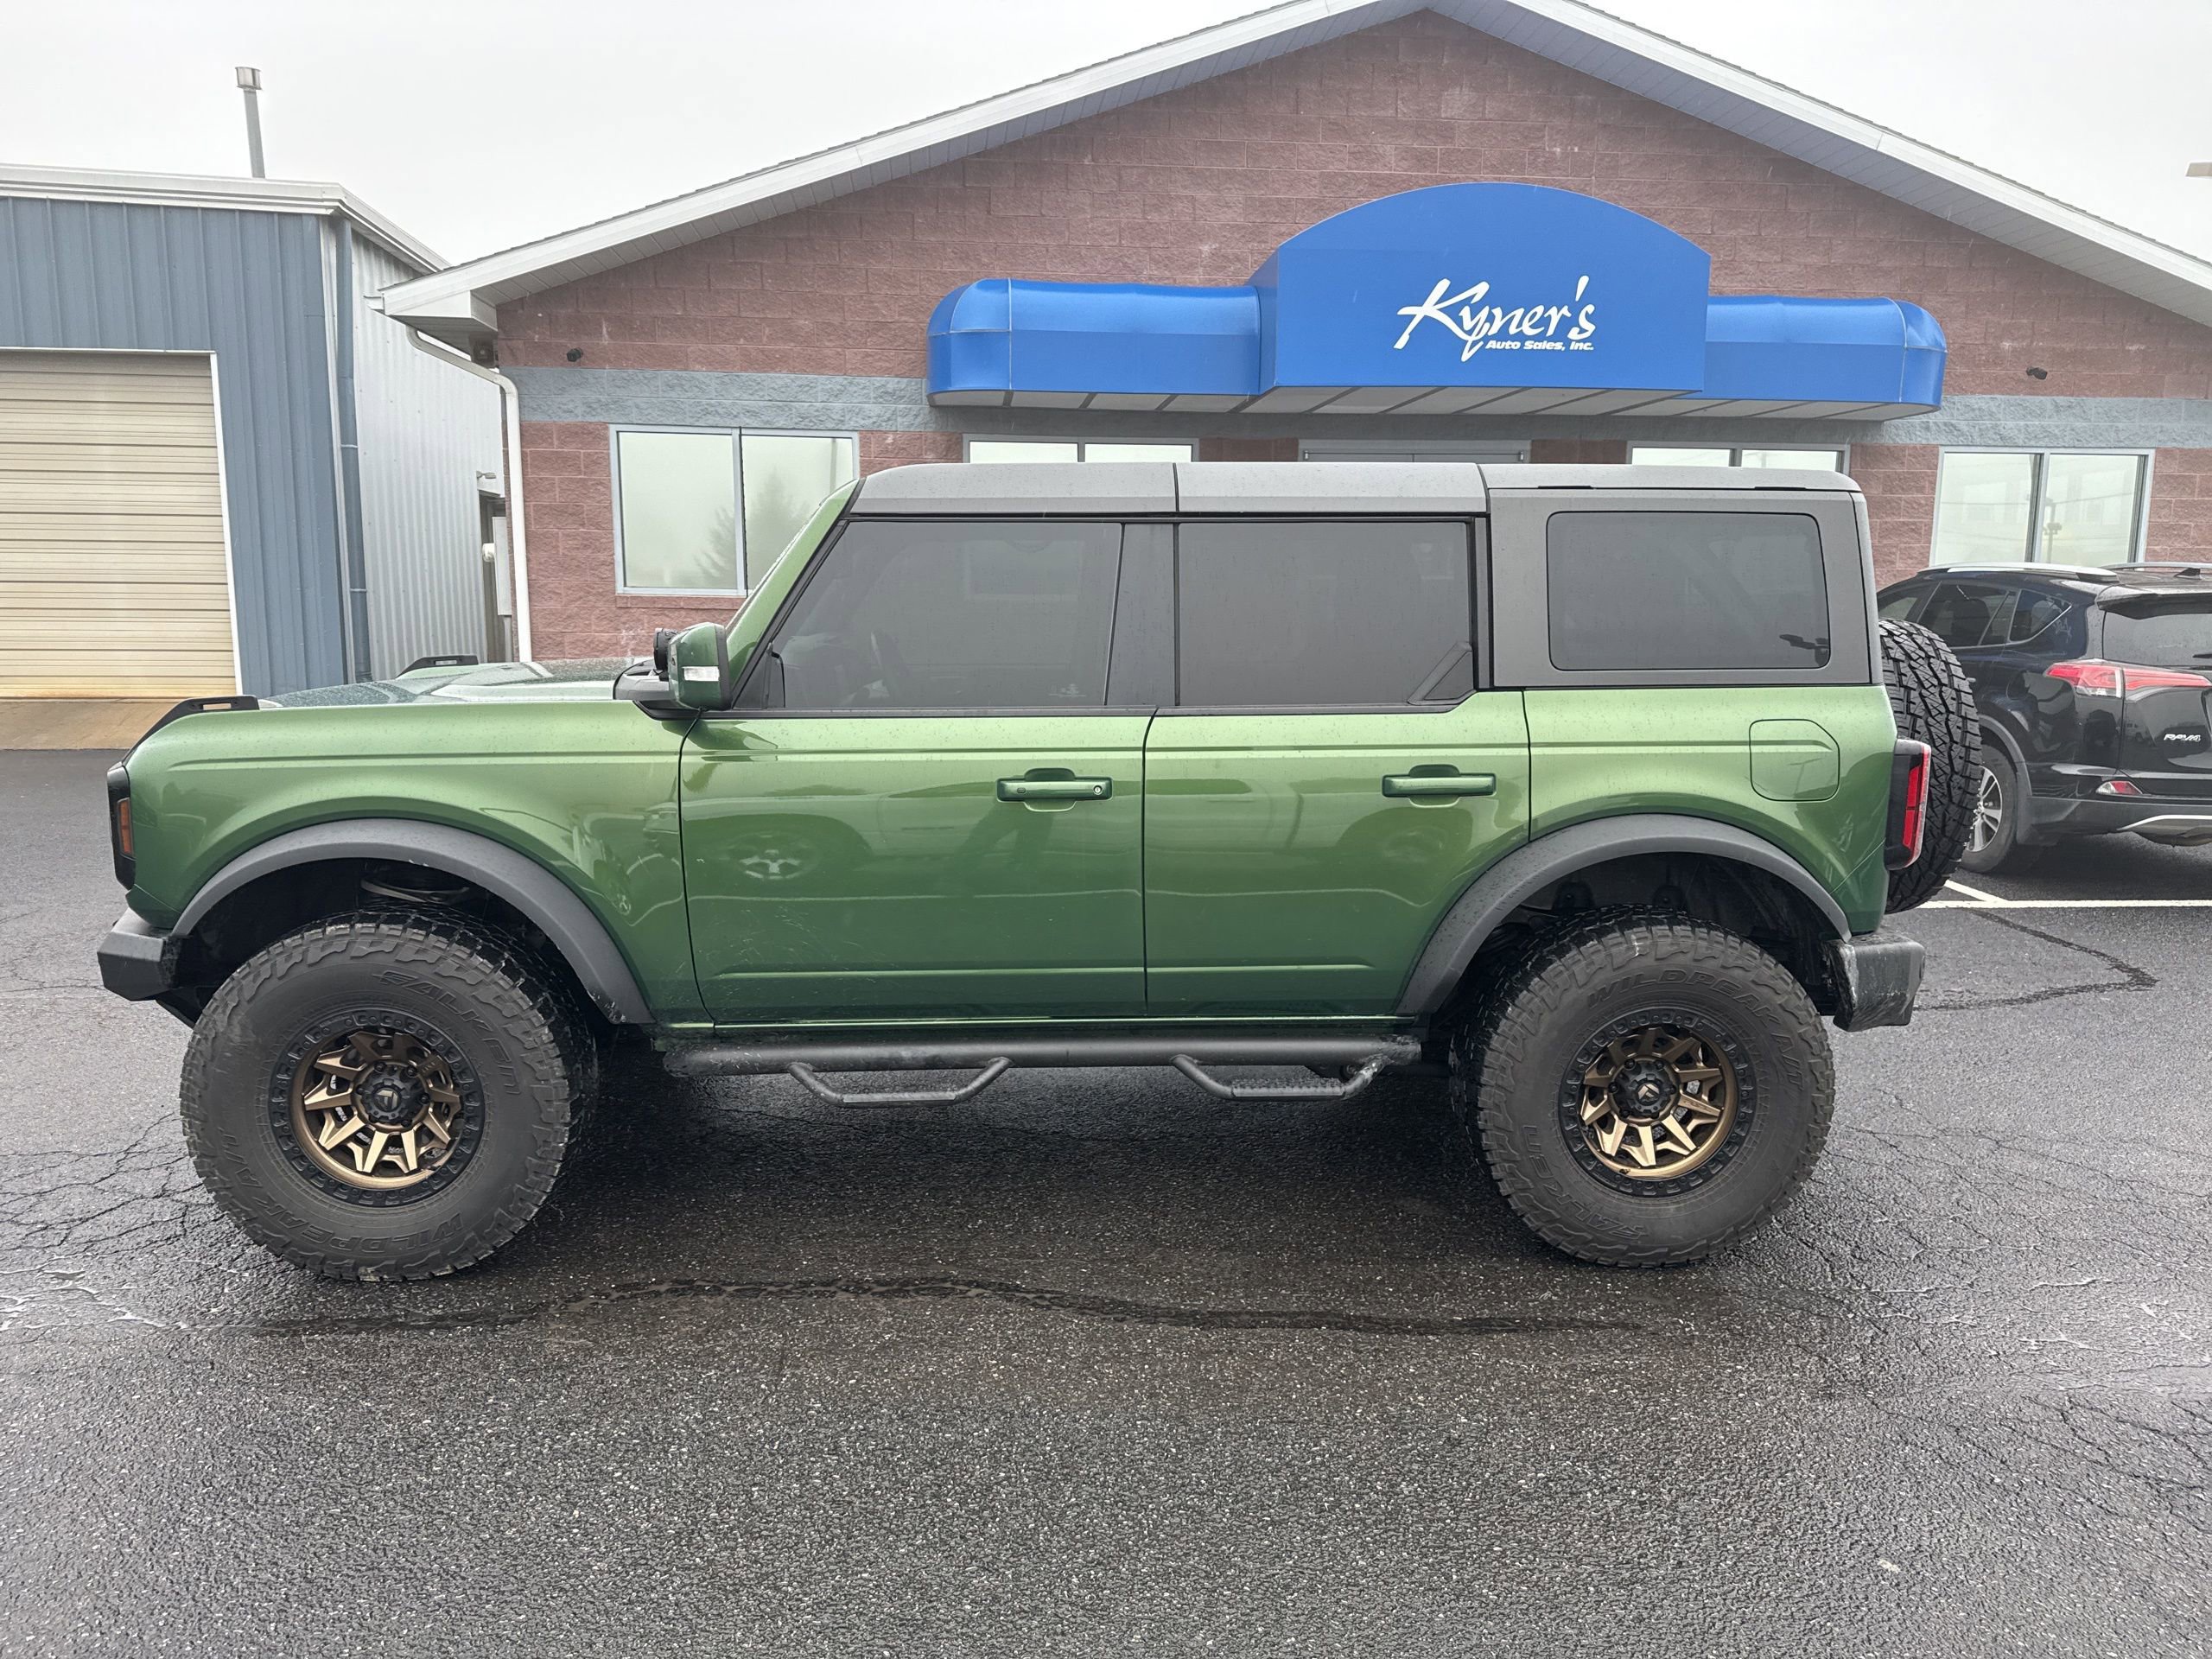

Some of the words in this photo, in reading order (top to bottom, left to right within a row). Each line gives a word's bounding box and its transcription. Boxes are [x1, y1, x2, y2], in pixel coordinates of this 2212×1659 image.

[1393, 275, 1597, 363] Kyner's
[1484, 340, 1521, 351] Auto
[1522, 340, 1566, 352] Sales,
[1569, 340, 1595, 352] Inc.
[2163, 734, 2202, 742] RAV4
[1587, 968, 1781, 1027] WILDPEAK
[372, 969, 522, 1095] FALKEN
